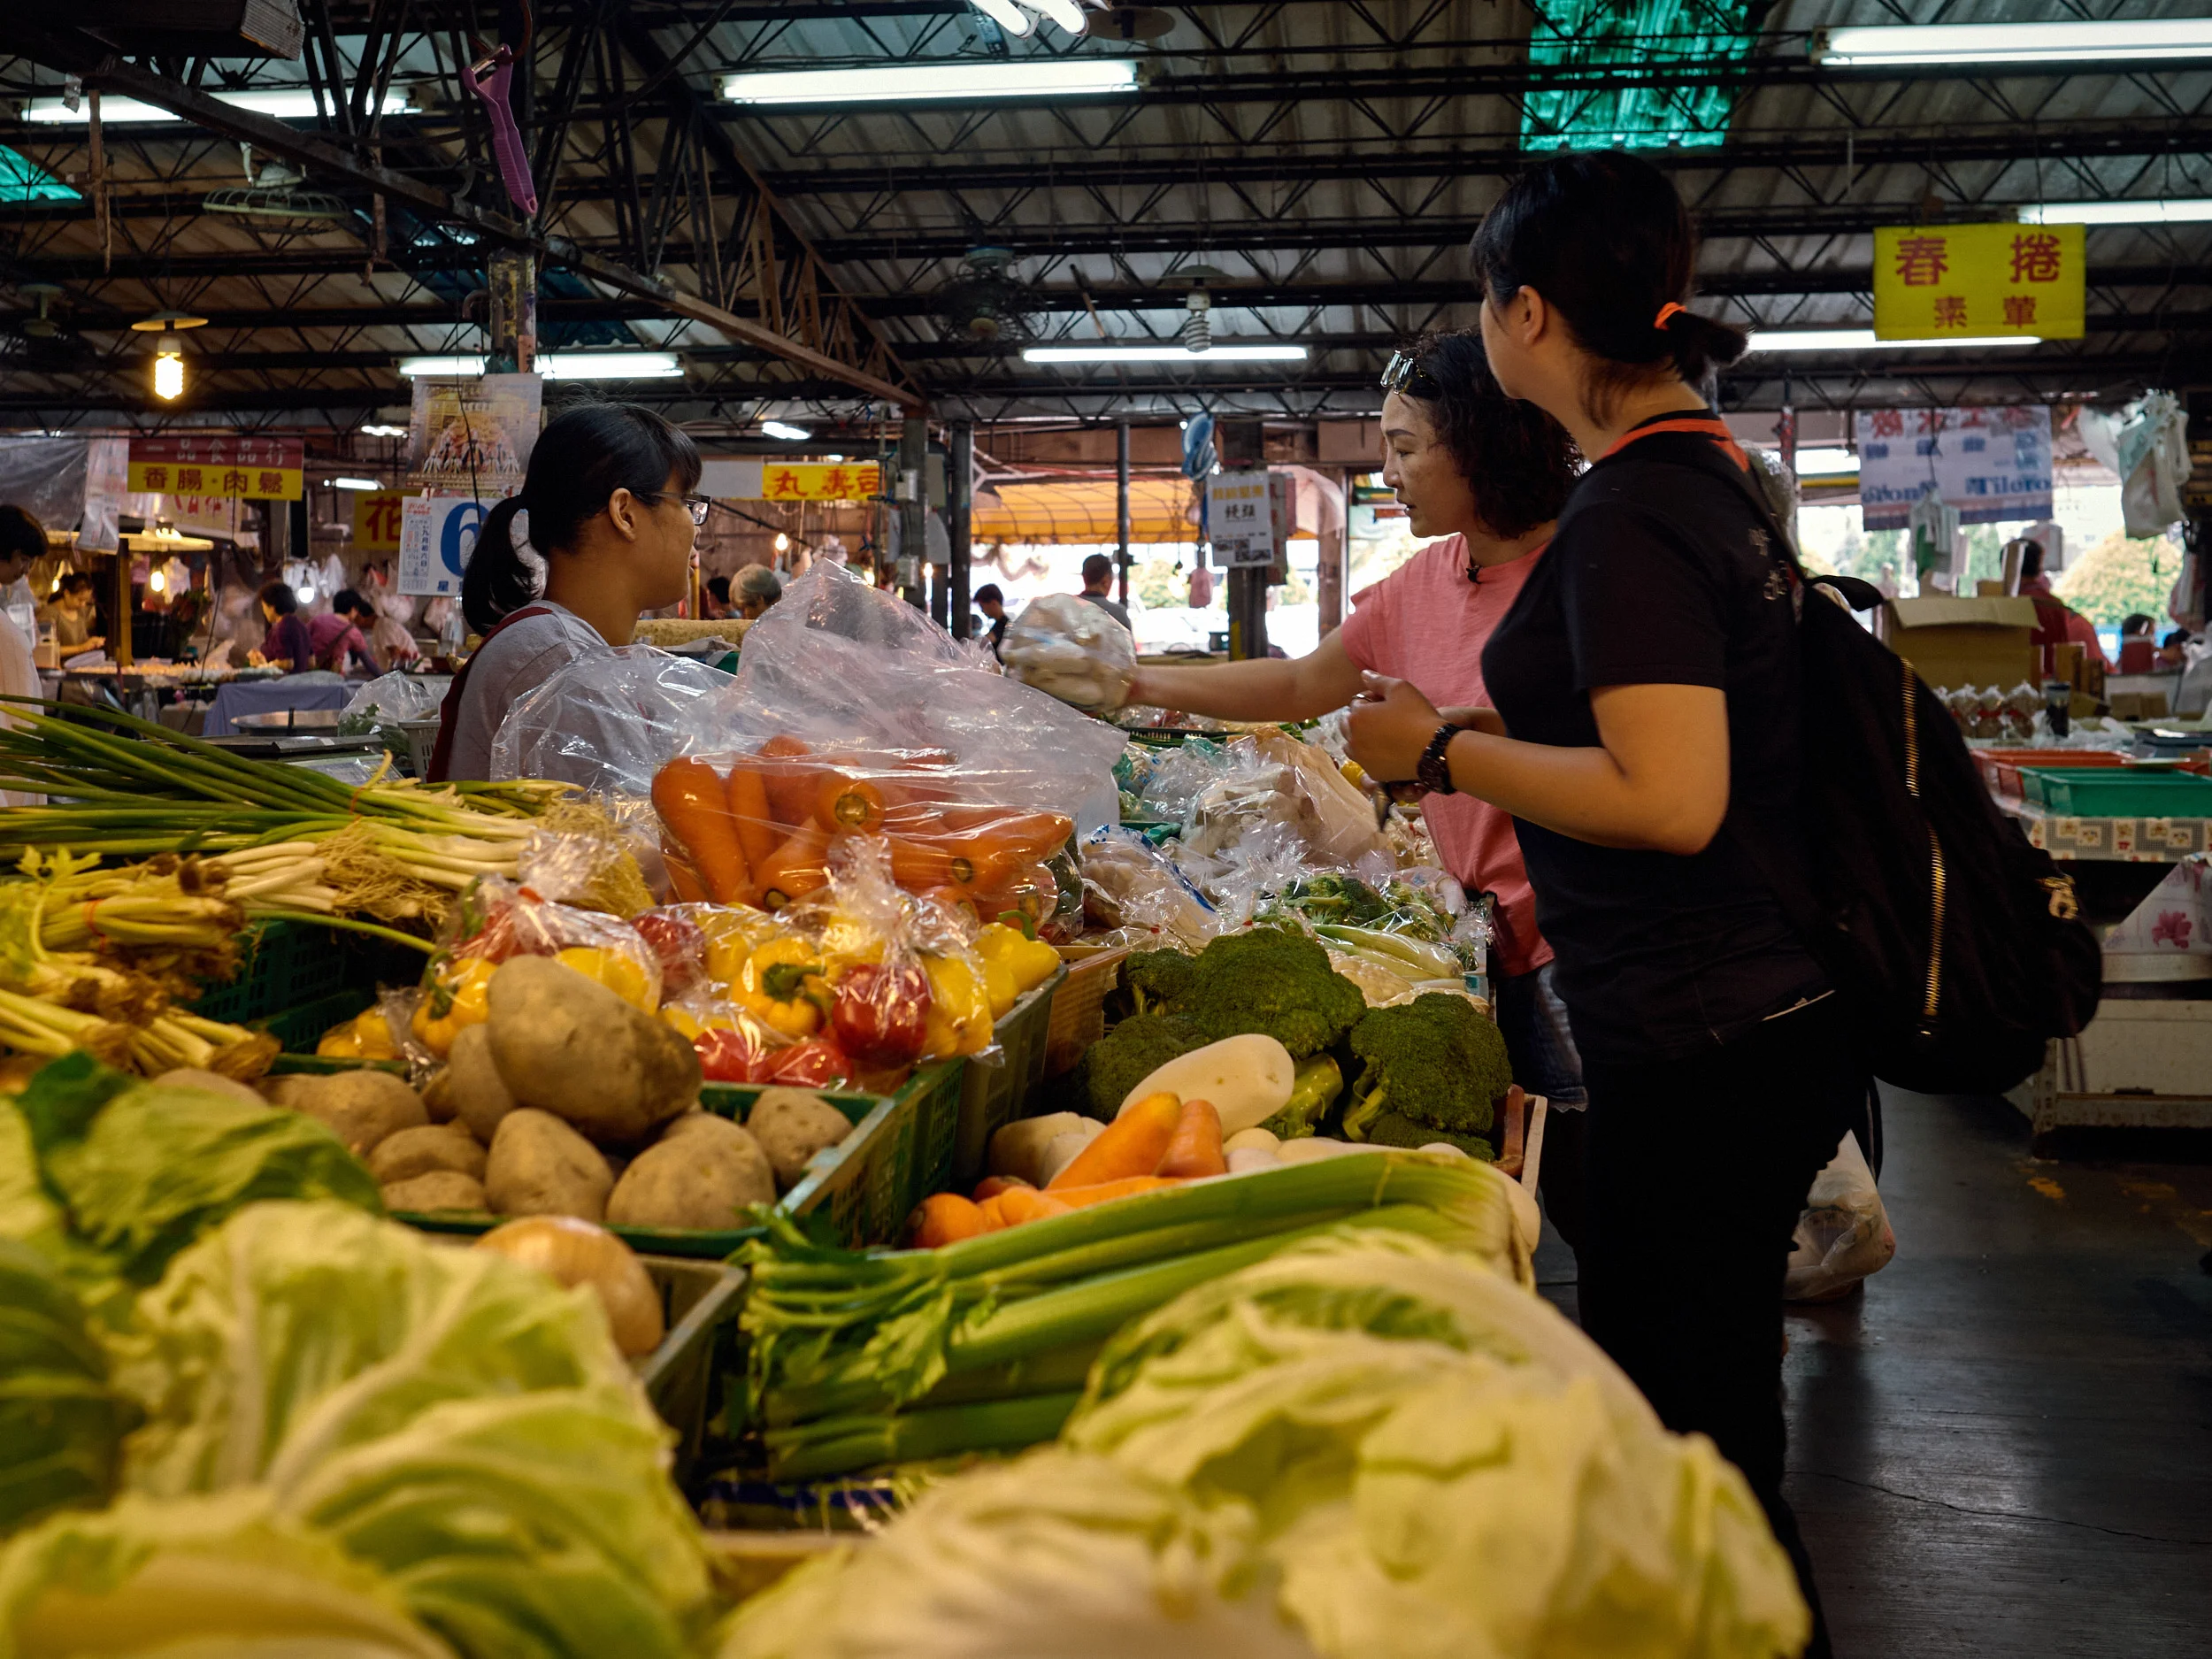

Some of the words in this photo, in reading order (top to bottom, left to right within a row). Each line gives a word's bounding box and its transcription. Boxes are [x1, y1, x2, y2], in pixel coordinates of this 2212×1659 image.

[1895, 234, 2062, 286] 春捲
[763, 467, 879, 499] 丸壽司
[441, 502, 489, 578] 6
